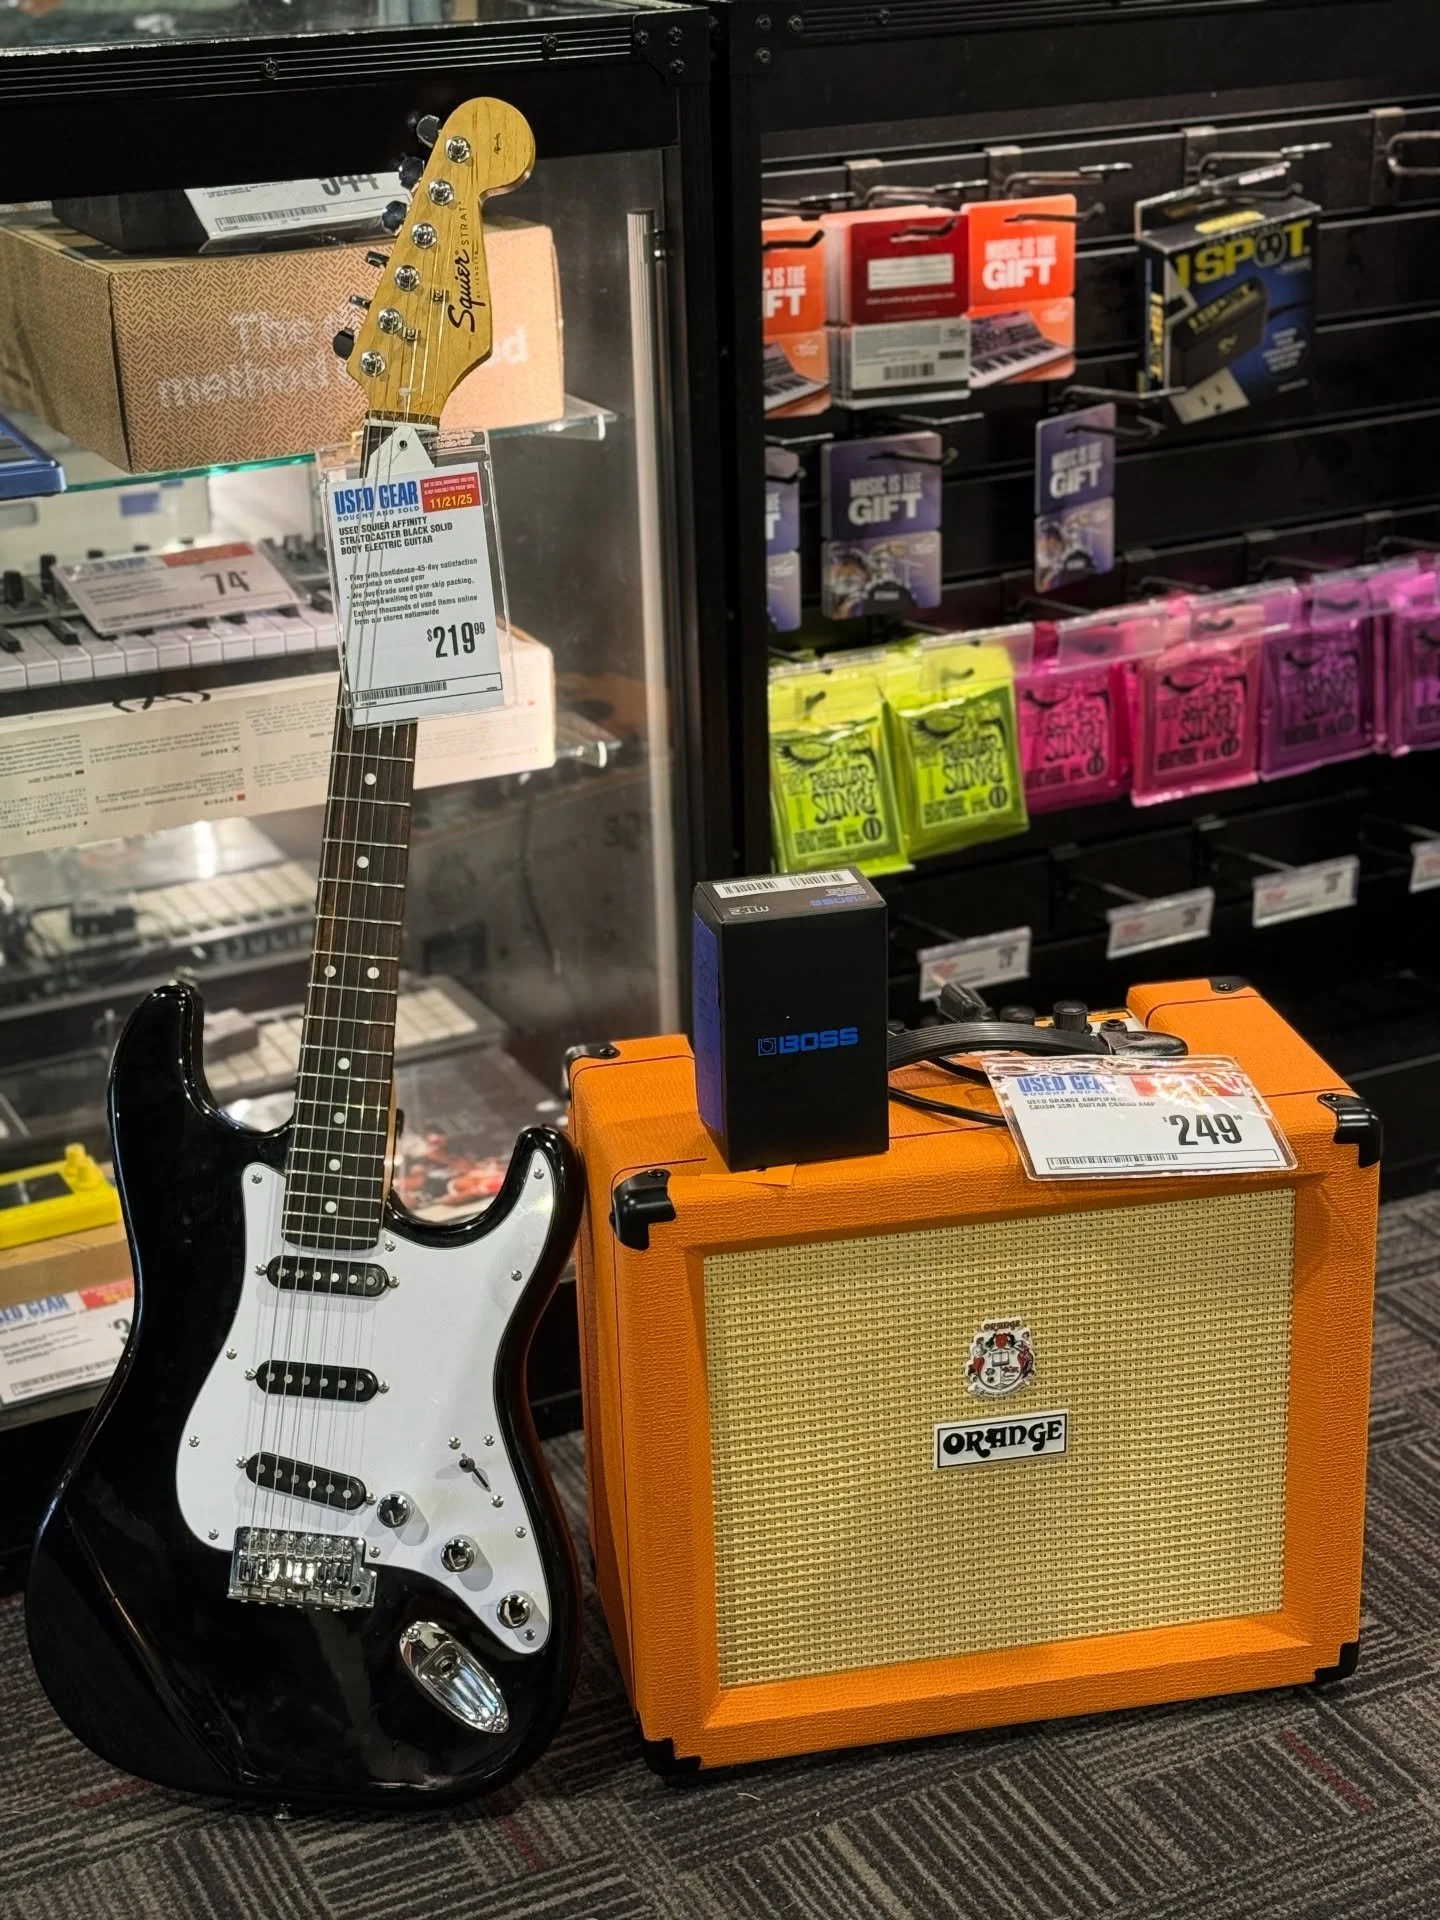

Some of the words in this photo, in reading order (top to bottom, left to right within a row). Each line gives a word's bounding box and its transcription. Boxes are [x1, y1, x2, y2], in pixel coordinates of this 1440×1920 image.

[457, 206, 470, 246] STRAT
[982, 256, 1057, 291] GIFT
[447, 248, 486, 333] Squier
[1050, 461, 1102, 499] GIFT
[334, 486, 375, 515] USED
[378, 480, 419, 509] GEAR
[376, 509, 394, 517] AND
[398, 505, 420, 514] SOLD
[430, 493, 473, 510] 11/21/25
[848, 492, 923, 526] GIFT
[338, 526, 359, 536] USED
[361, 521, 390, 533] SQUIER
[392, 516, 427, 529] AFFINITY
[340, 530, 401, 546] STRATOCASTER
[402, 526, 429, 536] BLACK
[430, 522, 453, 532] SOLID
[341, 545, 363, 556] BODY
[364, 539, 402, 552] ELECTRIC
[404, 535, 433, 547] GUITAR
[779, 1026, 859, 1054] BOSS
[1017, 1075, 1066, 1093] USED
[943, 1419, 1063, 1459] ORANGE
